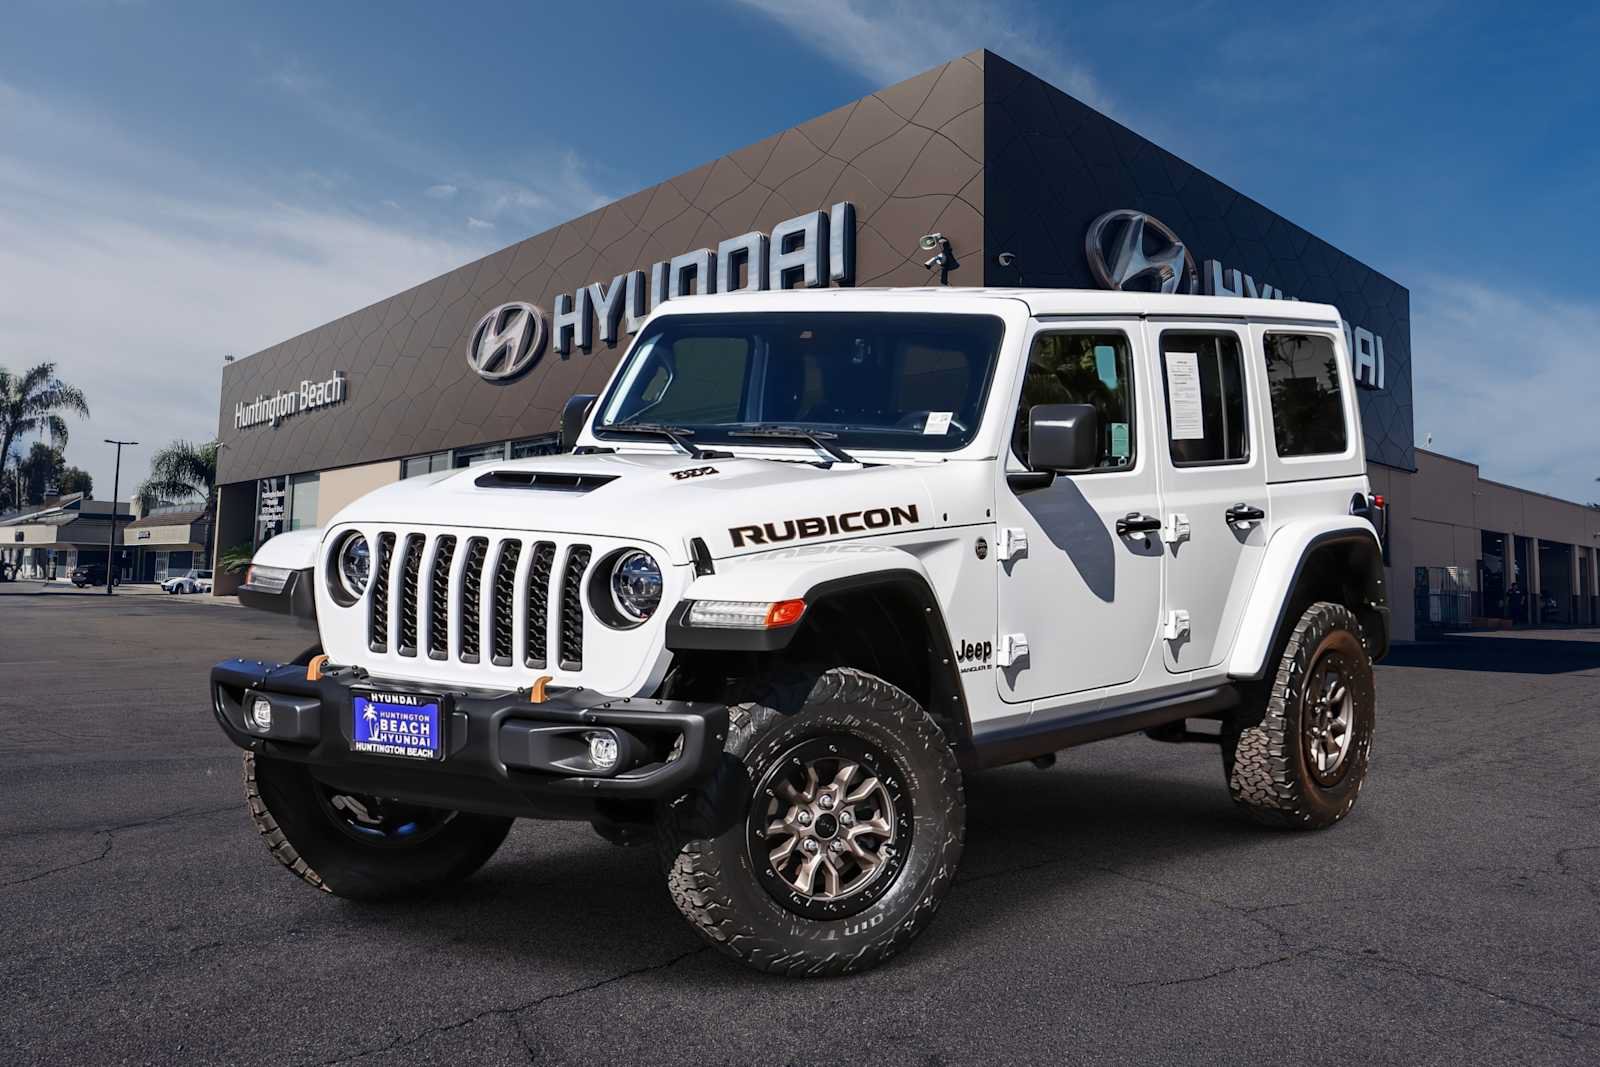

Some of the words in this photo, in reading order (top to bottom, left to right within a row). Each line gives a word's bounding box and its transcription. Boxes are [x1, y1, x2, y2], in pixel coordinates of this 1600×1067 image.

[553, 201, 855, 354] HYUNDAI
[234, 389, 299, 428] Huntington
[299, 370, 345, 411] Beach
[728, 504, 919, 548] RUBICON
[956, 639, 992, 664] Jeep
[371, 693, 417, 704] HYUNDAI
[380, 711, 430, 722] HUNTINGTON
[380, 719, 430, 735] BEACH
[380, 733, 430, 746] HYUNDAI
[355, 742, 405, 755] HUNTINGTON
[406, 748, 434, 758] BEACH
